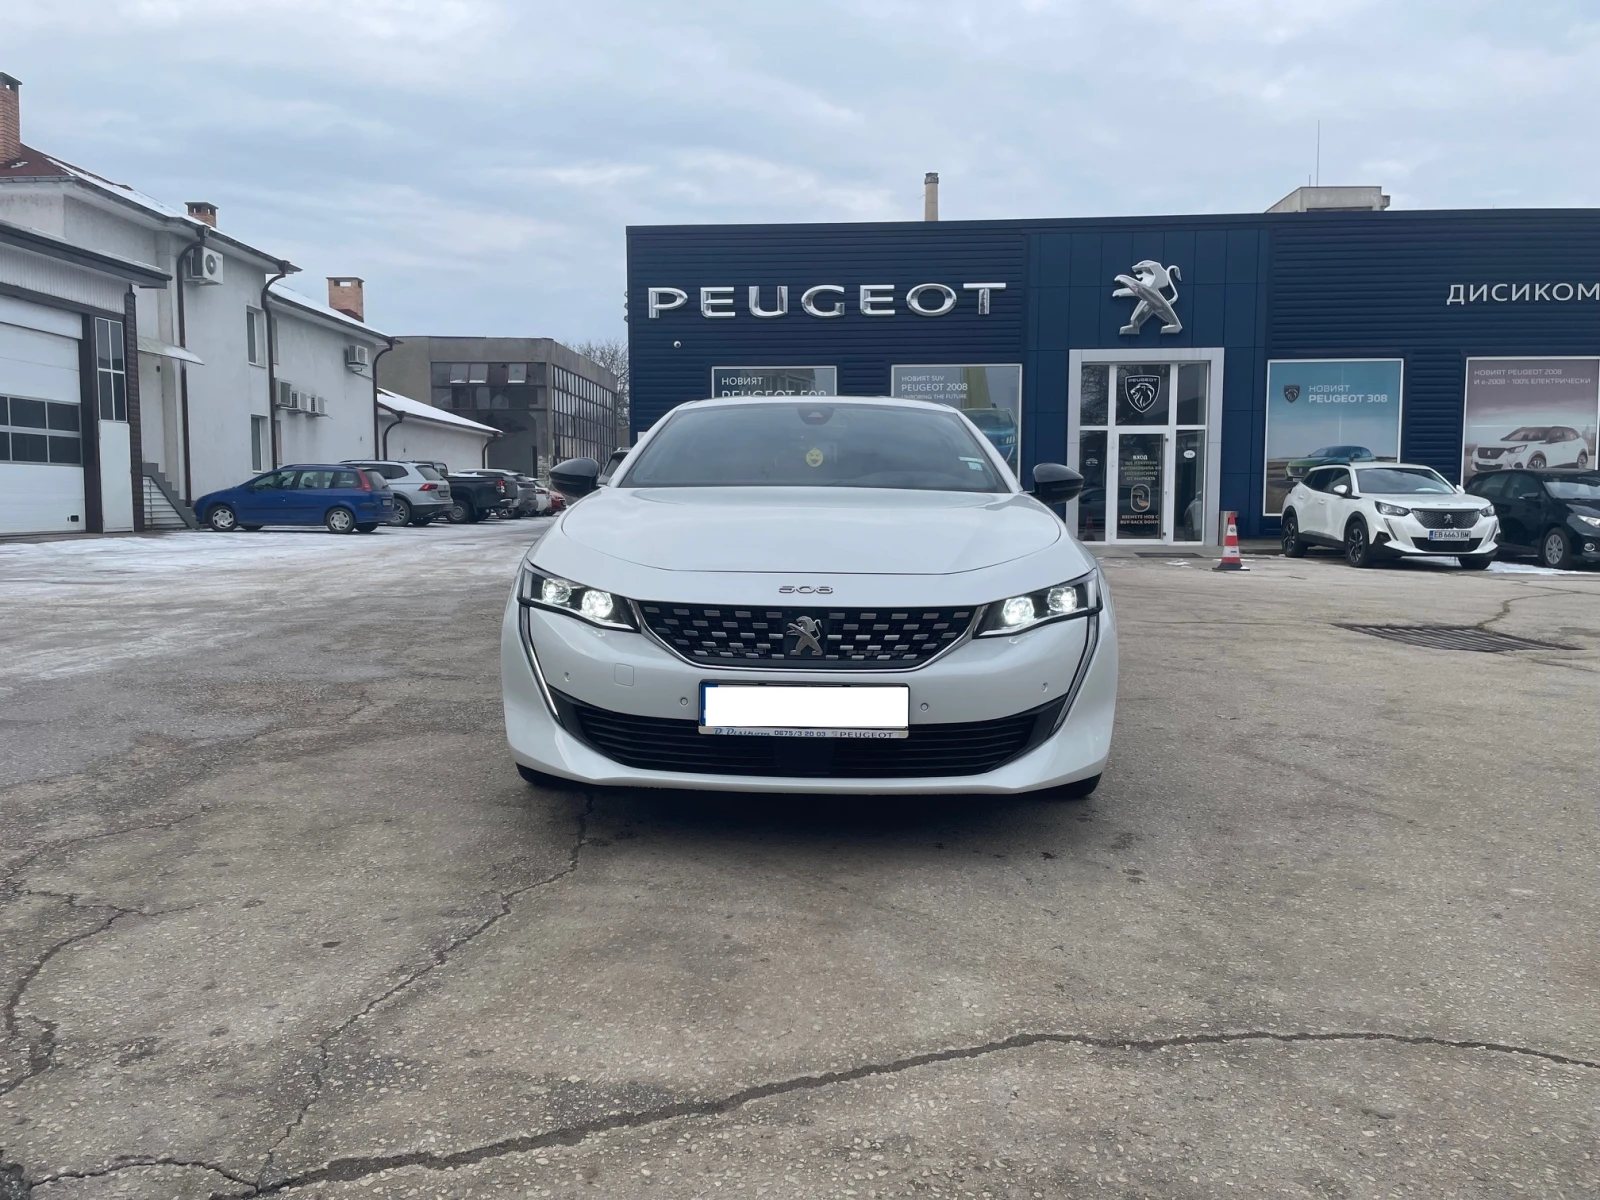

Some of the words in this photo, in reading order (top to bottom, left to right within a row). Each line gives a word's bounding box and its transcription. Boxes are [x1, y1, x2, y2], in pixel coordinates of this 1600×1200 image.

[1446, 282, 1600, 306] ДИСИКОМ
[648, 282, 1007, 319] PEUGEOT
[721, 376, 764, 386] НОВИЯТ
[901, 383, 944, 392] PEUGEOT
[946, 382, 968, 391] 2008
[1308, 394, 1364, 403] PEUGEOT
[1367, 394, 1388, 402] 308
[778, 586, 833, 594] 508
